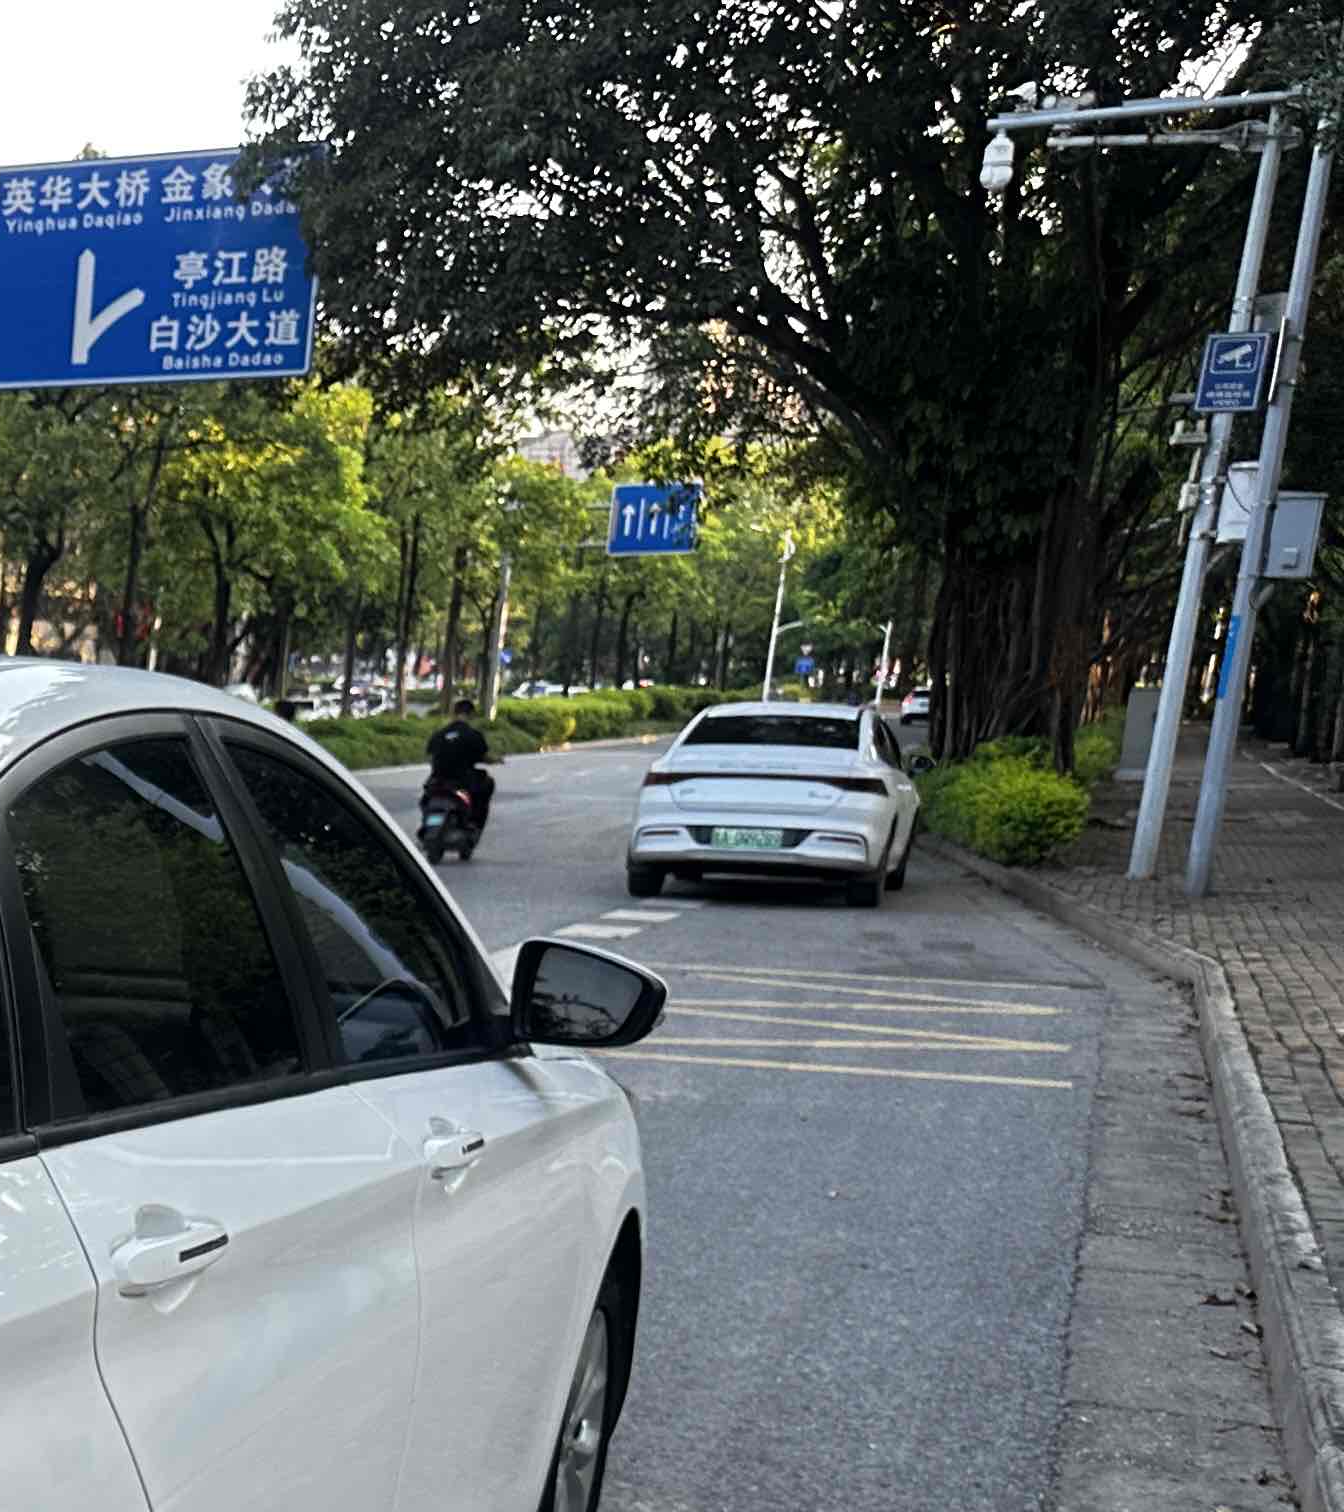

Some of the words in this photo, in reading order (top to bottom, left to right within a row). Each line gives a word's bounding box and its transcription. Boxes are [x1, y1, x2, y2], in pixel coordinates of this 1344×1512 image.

[1, 168, 151, 216] 英华大桥
[5, 217, 78, 236] Yinghua
[83, 211, 144, 231] Daqiao
[163, 203, 246, 224] Jinxiang
[251, 199, 297, 217] Dada
[173, 245, 288, 290] 亭江路
[171, 289, 257, 311] Tingjiang
[262, 288, 285, 303] Lu
[149, 308, 301, 353] 白沙大道
[162, 354, 224, 370] Baisha
[227, 351, 285, 368] Dadao
